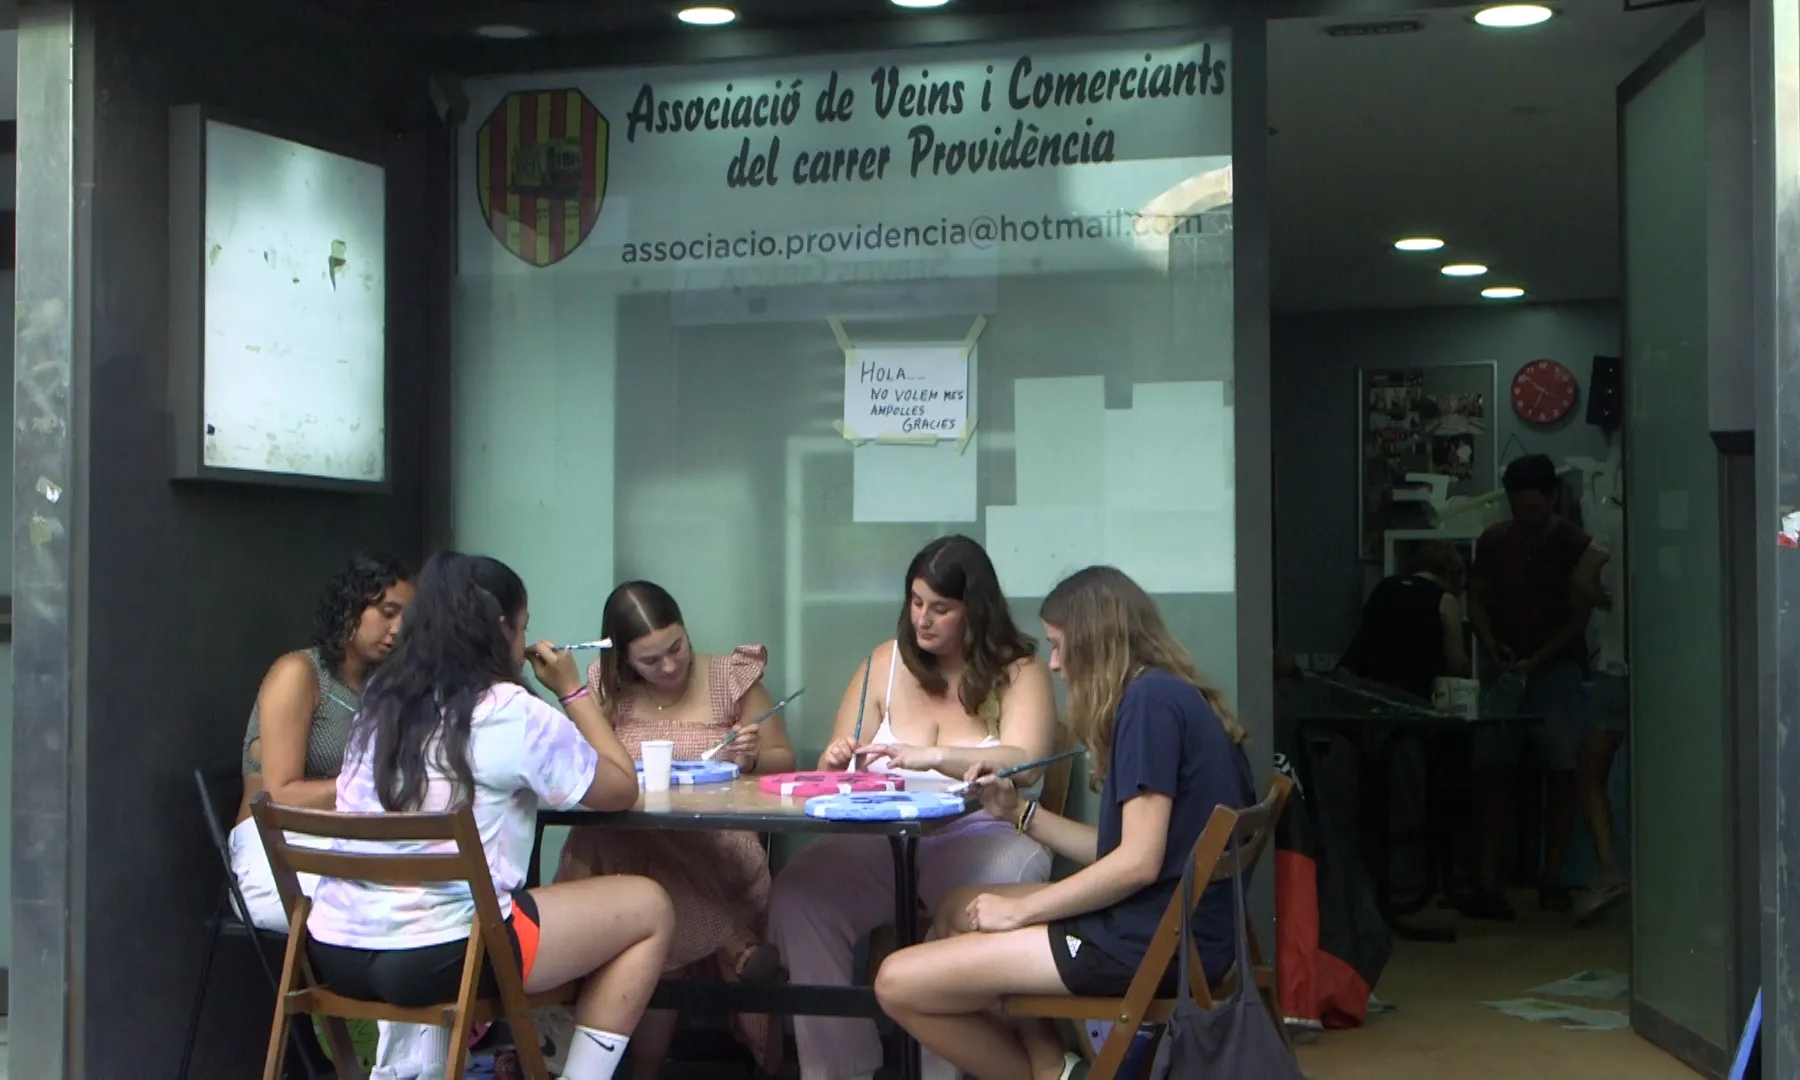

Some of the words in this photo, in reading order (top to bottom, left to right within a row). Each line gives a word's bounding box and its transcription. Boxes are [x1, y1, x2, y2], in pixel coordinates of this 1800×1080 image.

[626, 78, 803, 143] Associació
[815, 69, 854, 123] de
[871, 65, 965, 119] Veins
[981, 65, 993, 112] i
[1008, 43, 1226, 110] Comerciants
[727, 135, 780, 188] del
[793, 145, 890, 185] carrer
[908, 118, 1115, 178] Providència
[621, 206, 1202, 264] associacio.providencia@hotmail.com
[870, 387, 889, 401] NO
[894, 388, 938, 402] VOLEM
[943, 389, 964, 401] MES
[870, 404, 925, 418] AMPOLLES
